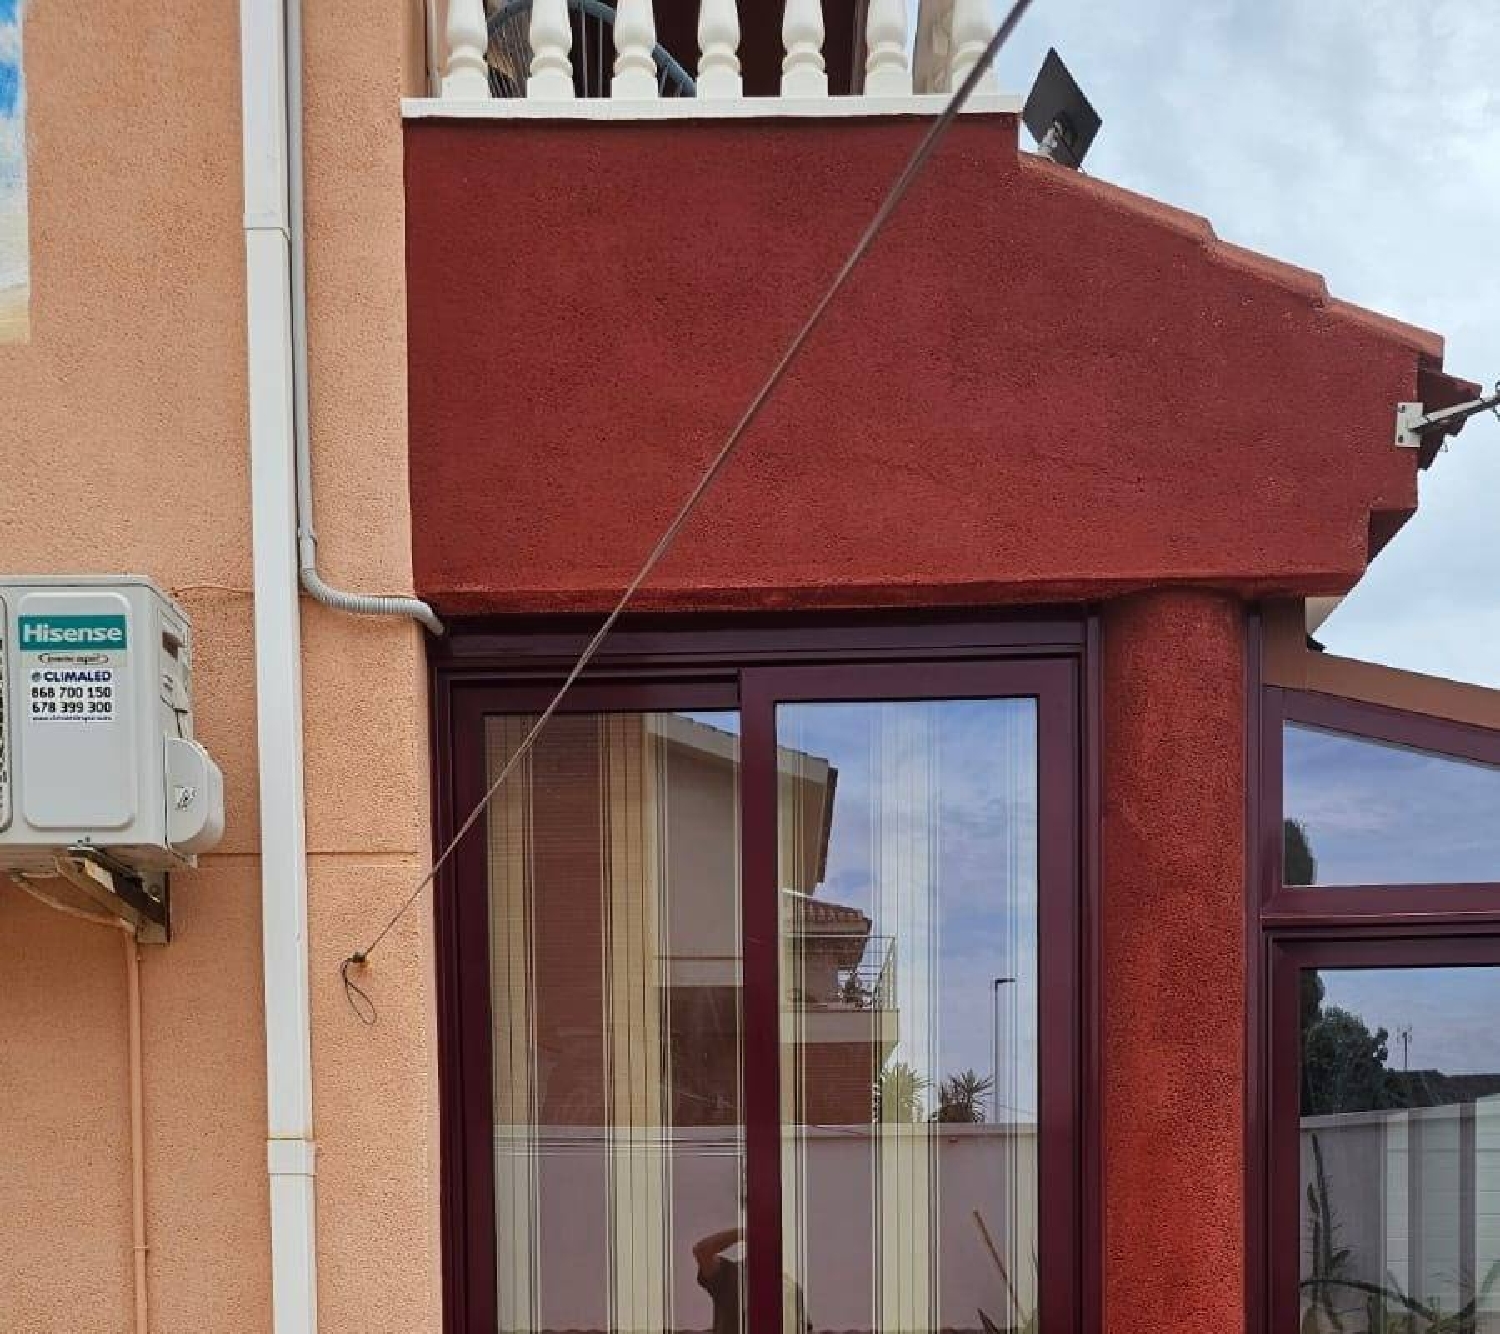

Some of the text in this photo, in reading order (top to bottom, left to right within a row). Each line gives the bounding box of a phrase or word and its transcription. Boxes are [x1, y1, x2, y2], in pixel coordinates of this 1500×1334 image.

[23, 622, 122, 642] Hisense
[44, 671, 111, 682] CLIMALED
[59, 687, 83, 698] 700
[87, 687, 112, 698] 150
[32, 702, 112, 713] 678 399 300
